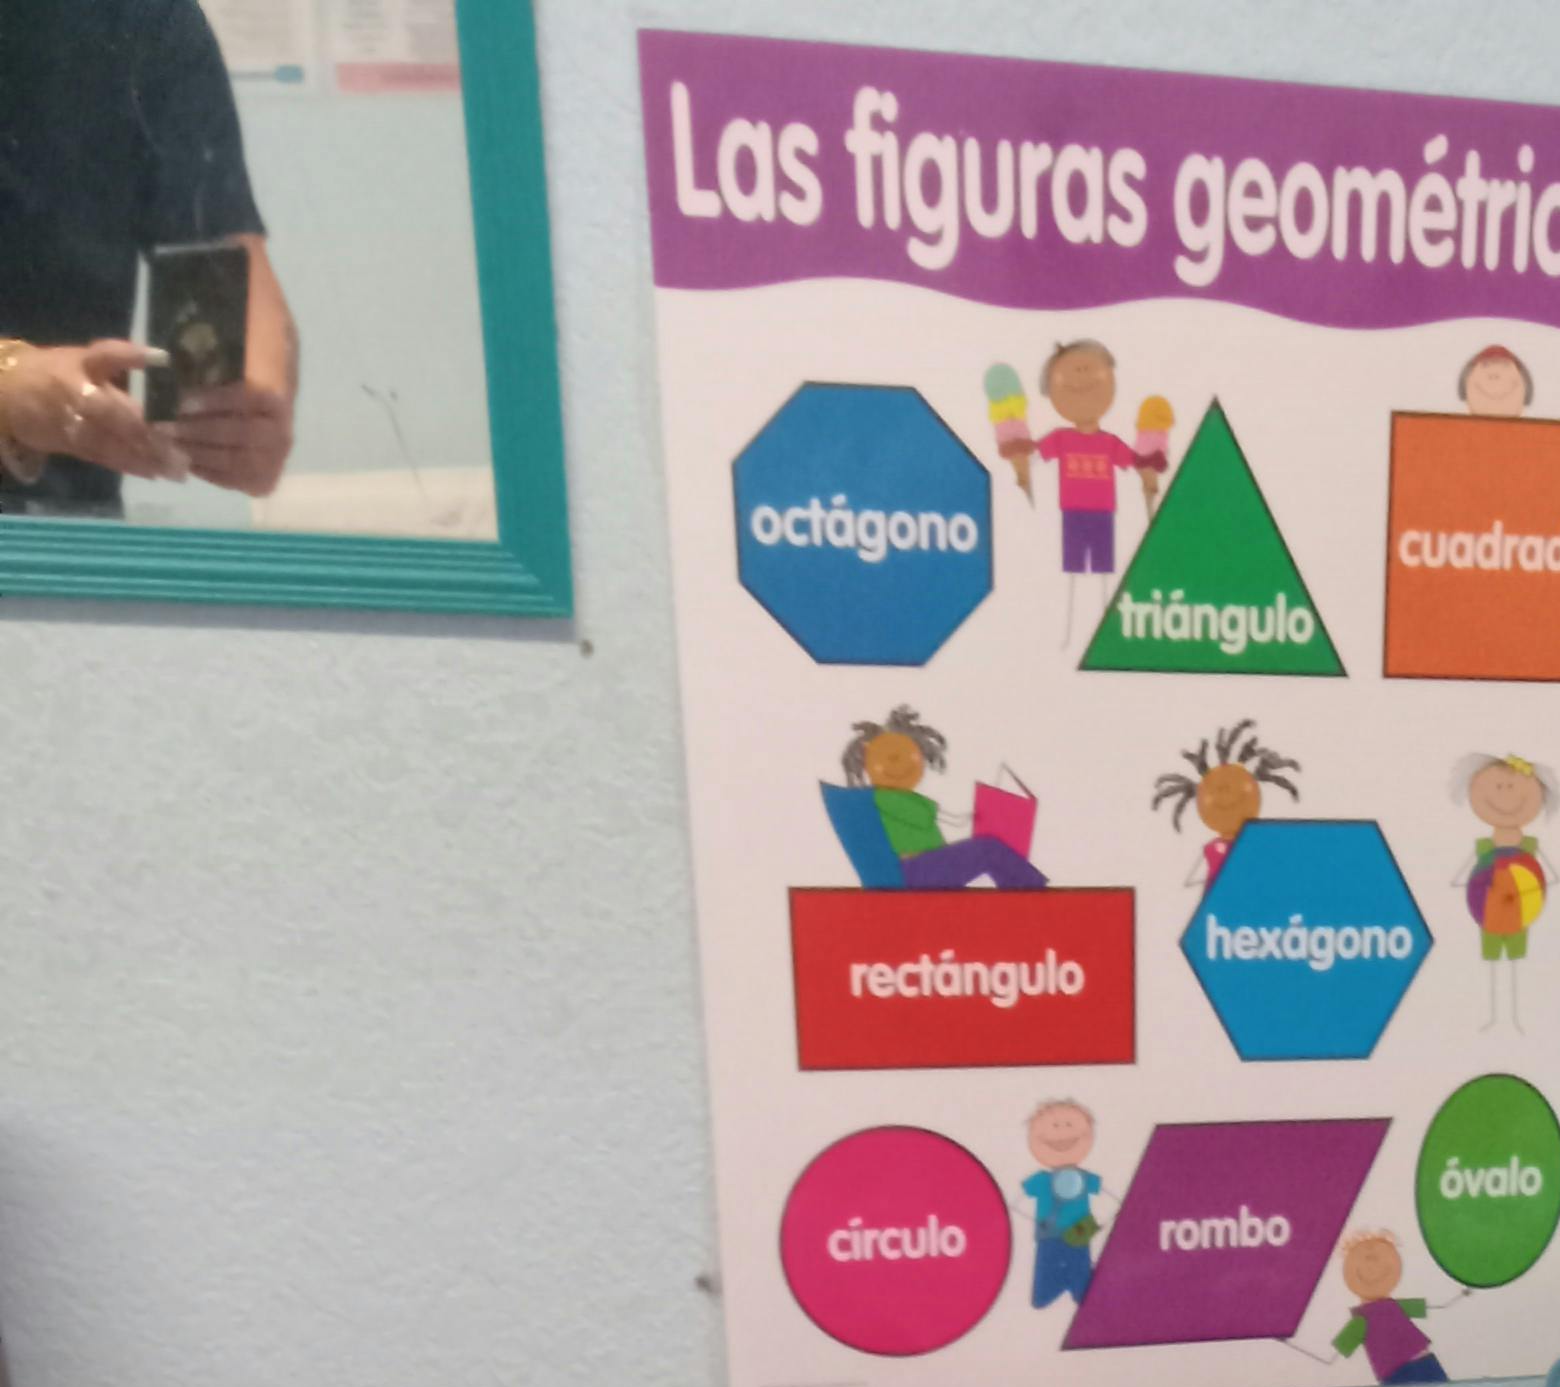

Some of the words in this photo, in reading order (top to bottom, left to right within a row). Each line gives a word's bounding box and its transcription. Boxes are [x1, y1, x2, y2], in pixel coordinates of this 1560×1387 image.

[670, 82, 822, 227] Las
[845, 86, 1147, 270] figuras
[750, 493, 978, 563] octágono
[1116, 590, 1316, 655] triángulo
[1205, 914, 1413, 972] hexágono
[849, 949, 1086, 1008] rectángulo
[1438, 1158, 1542, 1201] óvalo
[827, 1214, 966, 1262] círculo
[1160, 1207, 1292, 1252] rombo
